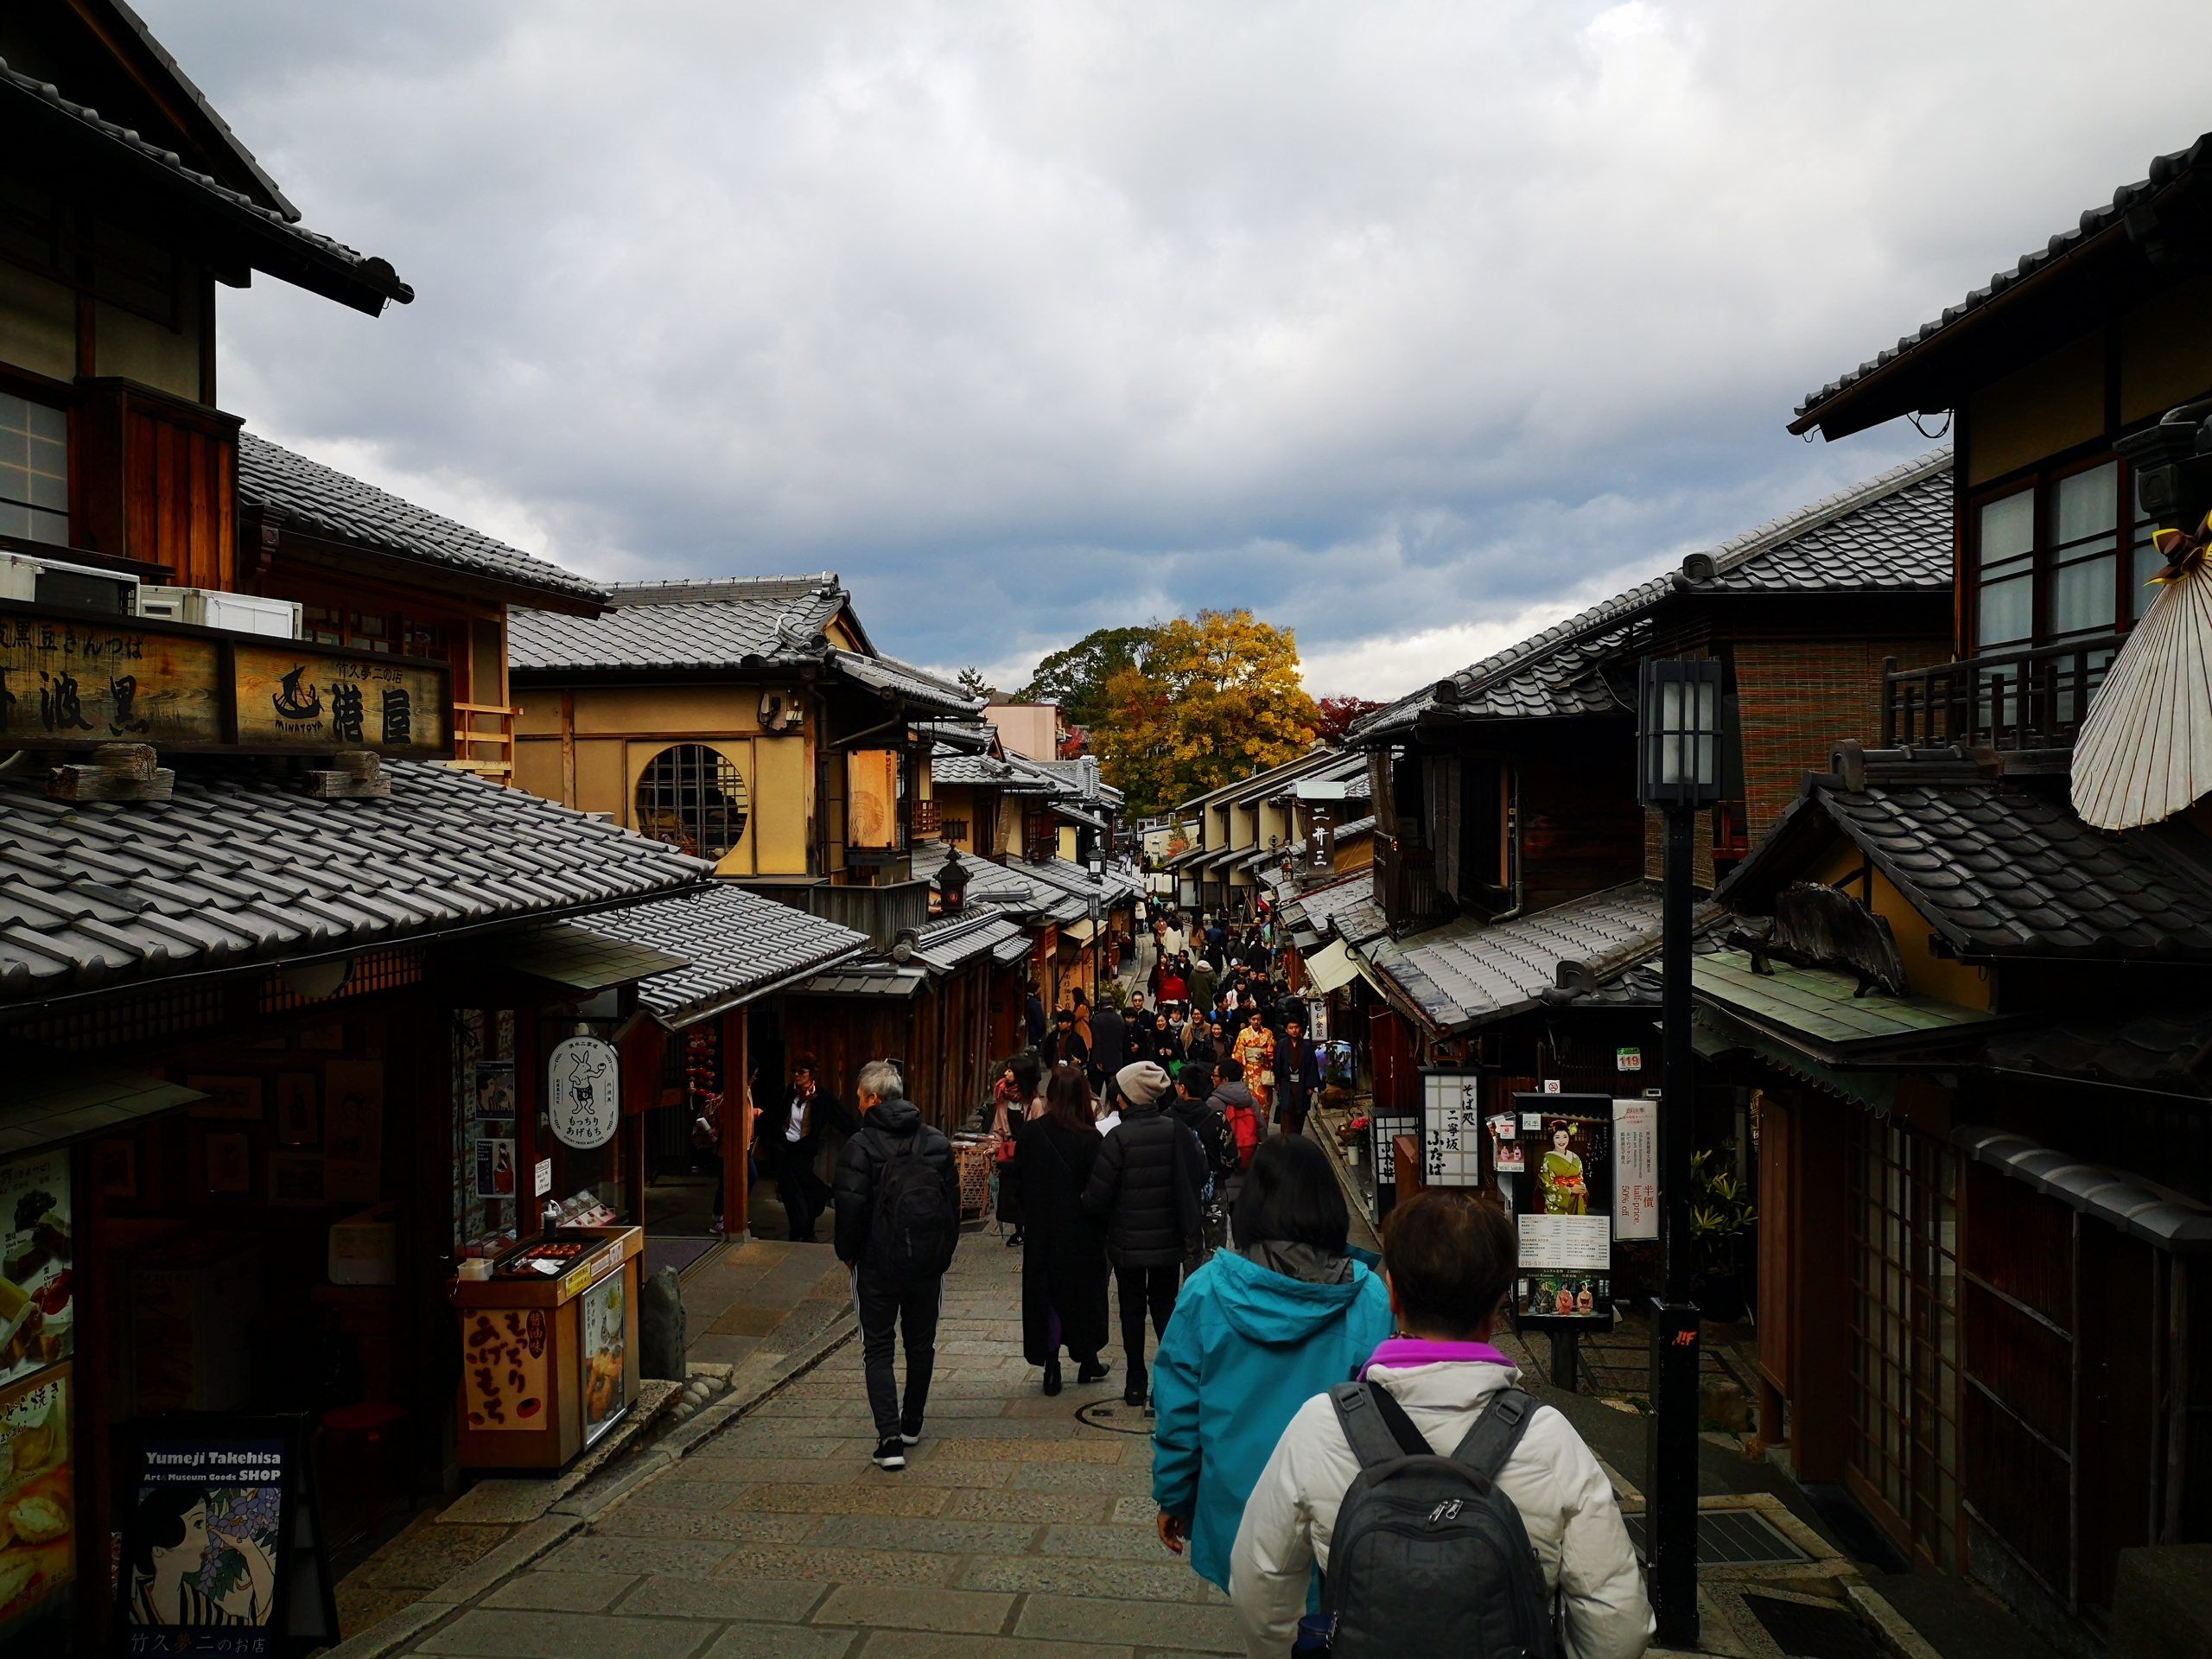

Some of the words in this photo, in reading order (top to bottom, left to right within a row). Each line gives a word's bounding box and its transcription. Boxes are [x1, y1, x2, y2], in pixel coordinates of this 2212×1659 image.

[336, 662, 404, 684] 竹久夢二の店
[331, 683, 412, 744] 港屋
[275, 719, 324, 733] MINATOYA
[1619, 1056, 1639, 1066] 119
[1461, 1084, 1475, 1126] そば処
[569, 1116, 599, 1126] もっちり
[1446, 1109, 1459, 1151] 二寧坂
[566, 1127, 601, 1138] あげもち
[1427, 1129, 1446, 1176] ふたば
[505, 1312, 527, 1394] もっちり
[469, 1315, 509, 1424] あげもち
[145, 1452, 206, 1467] Yumeji
[208, 1452, 281, 1465] Takehisa
[208, 1473, 237, 1482] Goods
[238, 1470, 282, 1481] SHOP
[130, 1632, 266, 1653] 竹久夢二のお店
